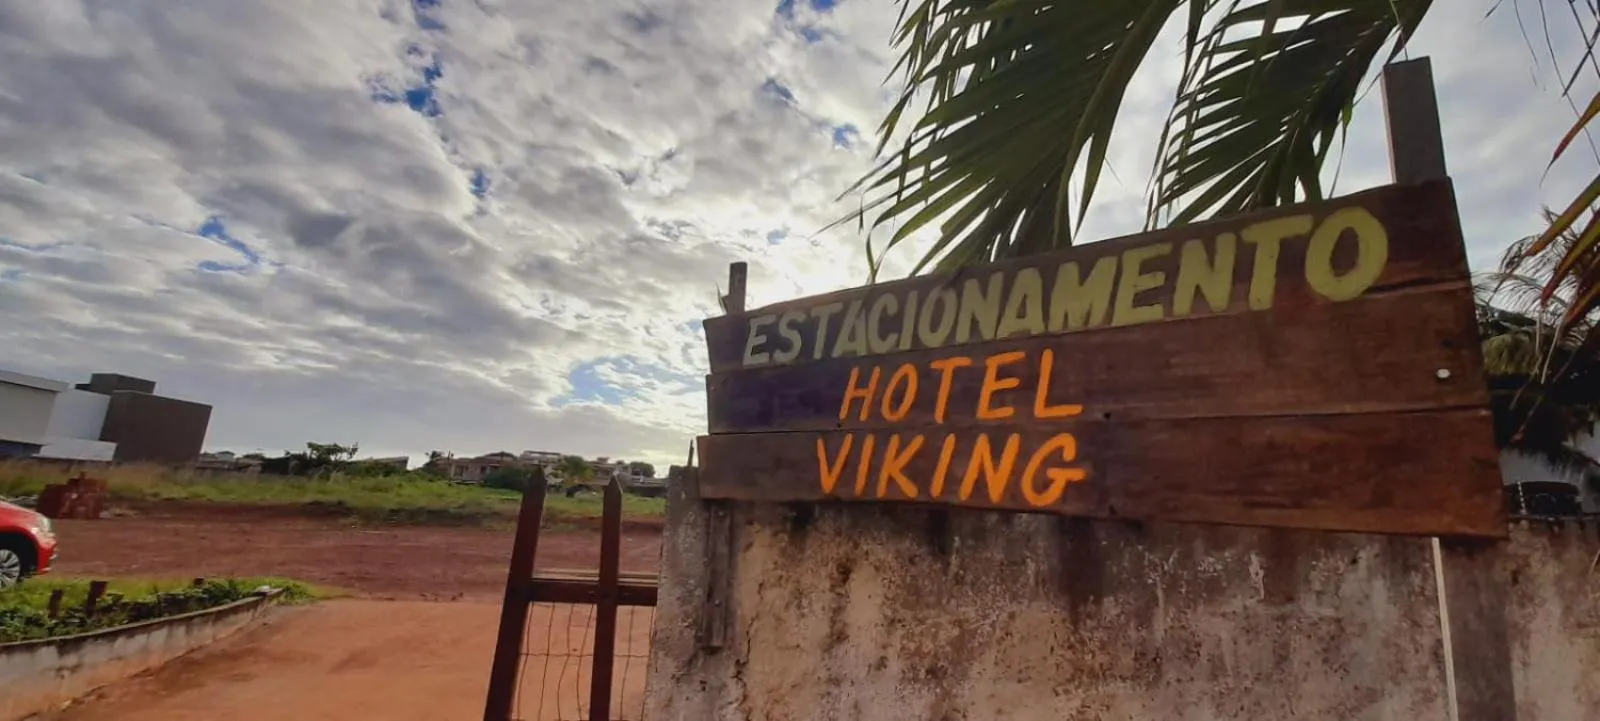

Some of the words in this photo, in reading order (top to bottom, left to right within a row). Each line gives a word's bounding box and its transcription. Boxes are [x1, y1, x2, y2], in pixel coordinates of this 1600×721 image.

[742, 207, 1389, 367] ESTACIONAMENTO
[839, 349, 1083, 423] HOTEL
[816, 433, 1086, 507] VIKING
